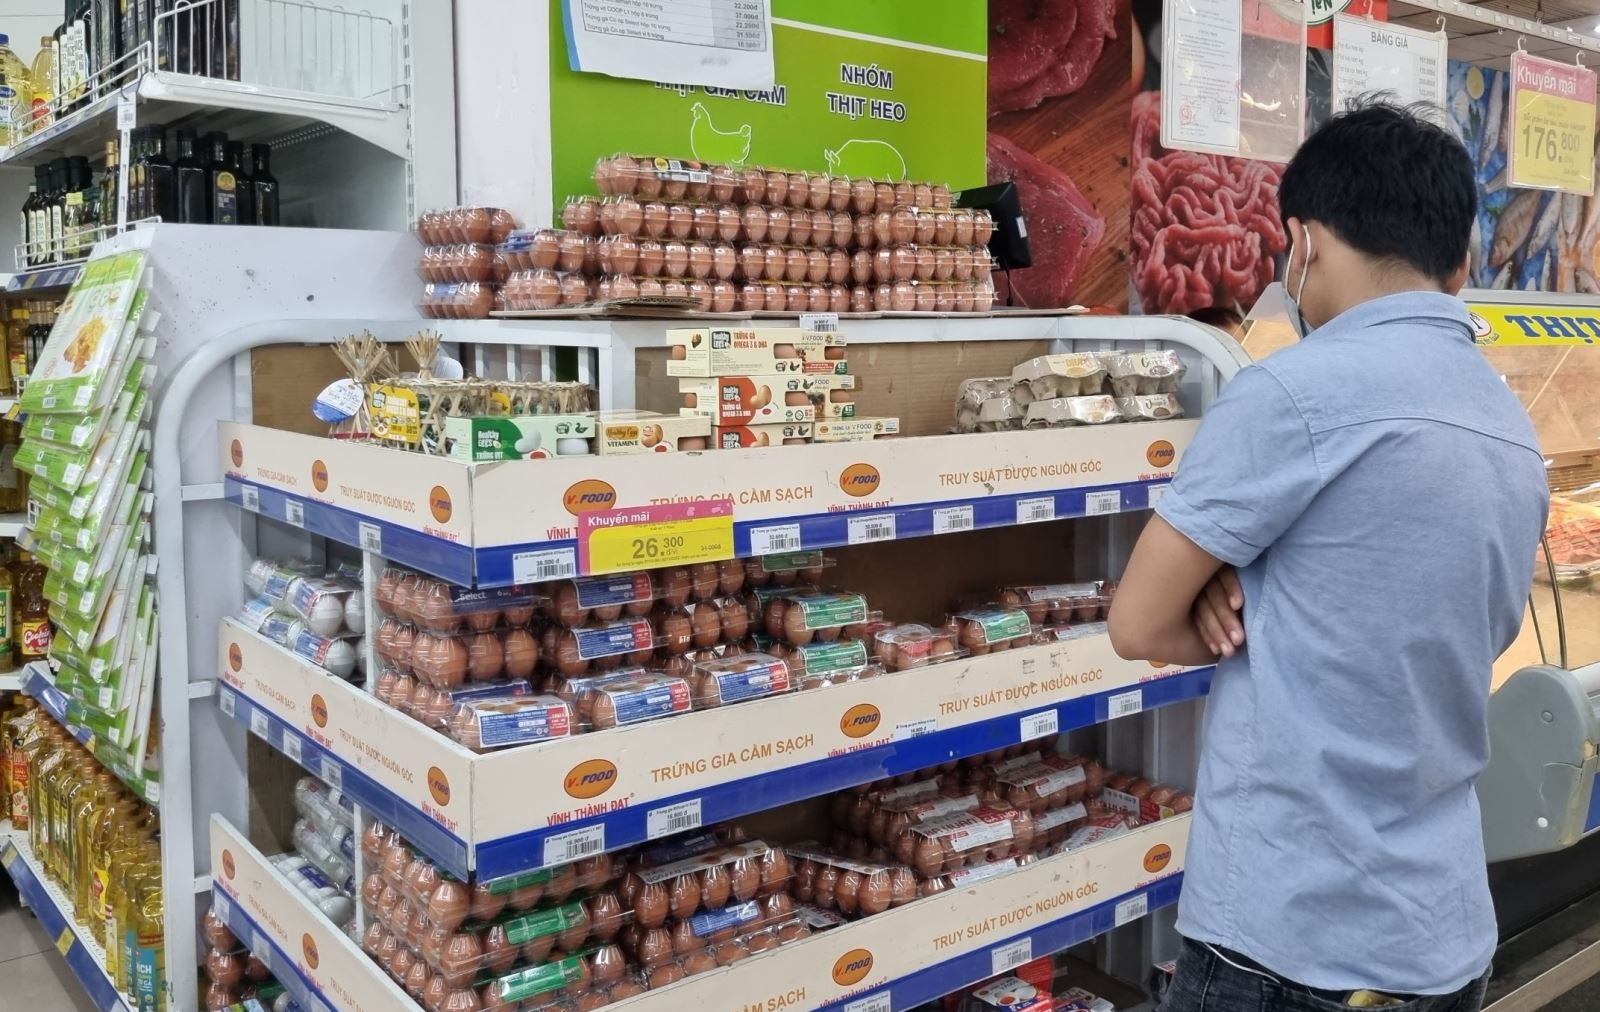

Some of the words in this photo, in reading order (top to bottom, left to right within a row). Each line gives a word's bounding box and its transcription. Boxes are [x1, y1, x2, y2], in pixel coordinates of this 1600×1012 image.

[841, 64, 892, 89] NHÓM
[1517, 65, 1557, 91] Khuyến
[1559, 75, 1577, 94] mãi
[827, 93, 866, 120] THỊT
[871, 101, 906, 121] HEO
[1561, 132, 1580, 152] 800
[1504, 315, 1600, 344] THỊT
[842, 475, 878, 486] V.FOOD
[939, 473, 970, 486] TRUY
[567, 492, 614, 505] V.FOOD
[776, 486, 813, 503] SẠCH
[588, 512, 628, 528] Khuyến
[630, 511, 650, 522] mãi
[546, 526, 570, 540] VĨNH
[664, 536, 684, 548] 300
[459, 592, 487, 600] Select
[940, 693, 970, 715] TRUY
[1005, 682, 1038, 702] ĐƯỢC
[843, 713, 878, 728] V.FOOD
[652, 759, 706, 783] TRỨNG
[712, 746, 737, 769] GIA
[776, 734, 814, 756] SẠCH
[567, 769, 614, 788] V.FOOD
[547, 812, 571, 826] VĨNH
[575, 802, 607, 821] THÀNH
[933, 929, 964, 950] TRUY
[1000, 905, 1033, 924] ĐƯỢC
[834, 957, 870, 978] V.FOOD
[768, 987, 806, 1011] SẠCH
